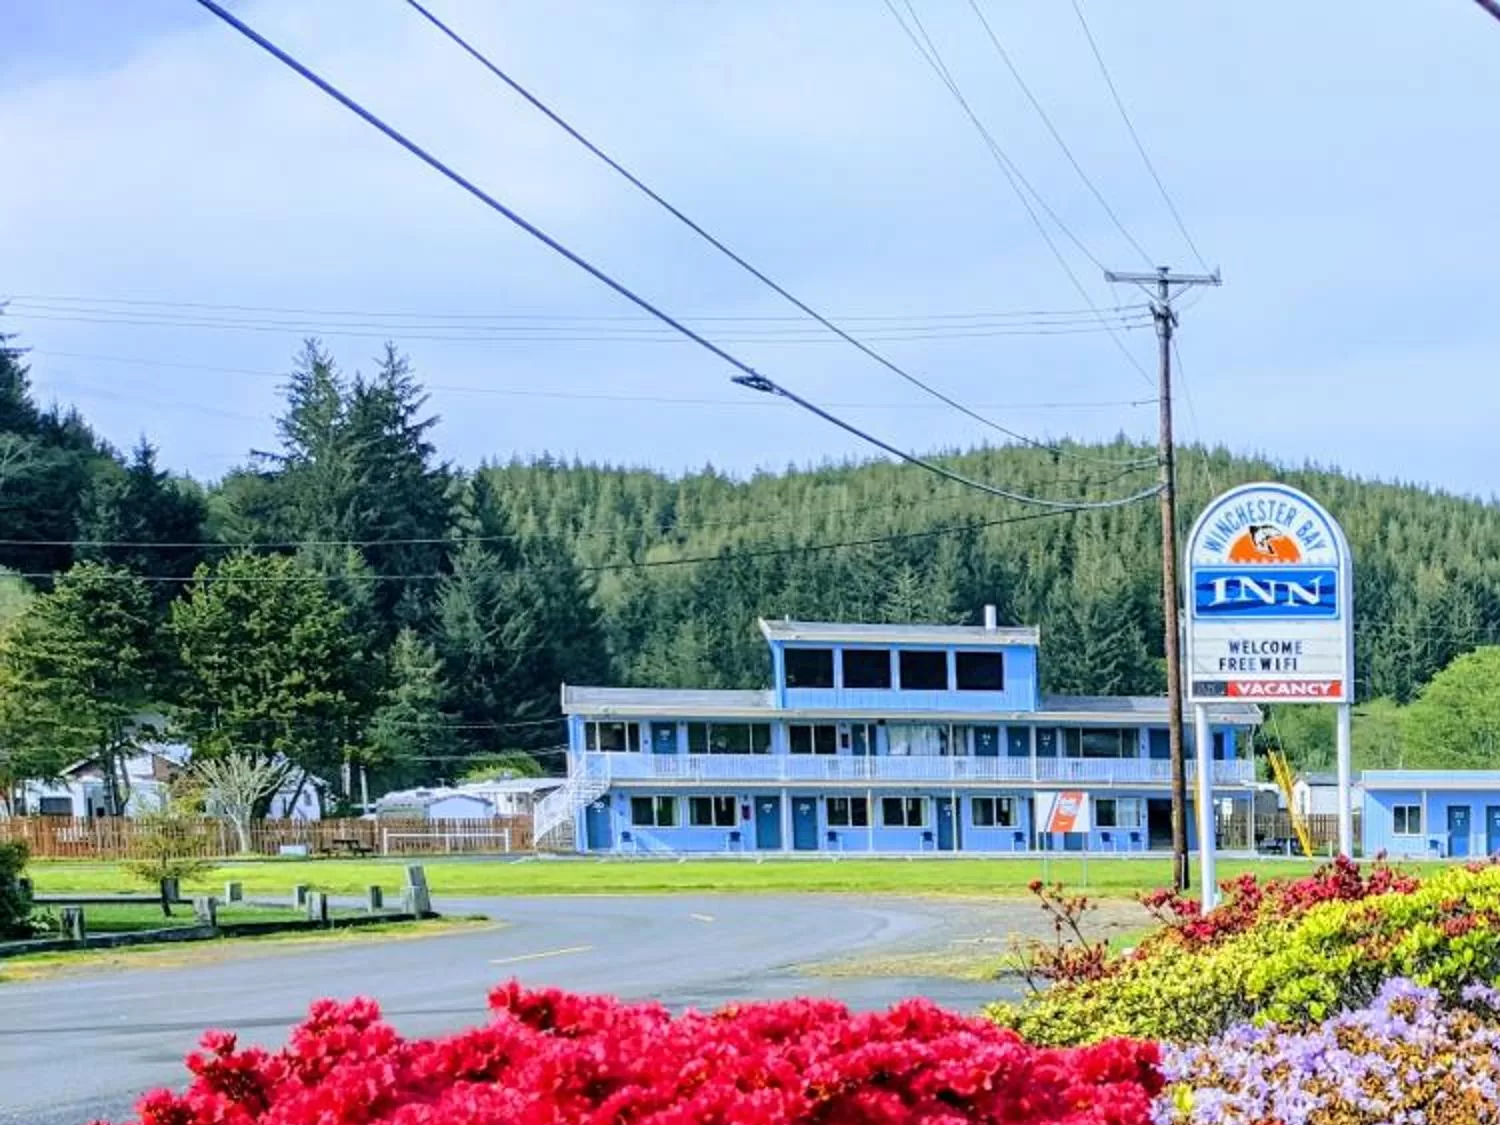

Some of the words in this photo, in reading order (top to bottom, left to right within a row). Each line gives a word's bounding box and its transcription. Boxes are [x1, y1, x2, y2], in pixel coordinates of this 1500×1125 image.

[1204, 499, 1297, 552] WINCHESTER
[1297, 520, 1325, 550] BAY
[1208, 575, 1322, 607] INN
[1229, 639, 1303, 655] WELCOME
[1219, 657, 1256, 671] FREE
[1260, 657, 1297, 671] WIFI
[1236, 682, 1331, 695] VACANCY
